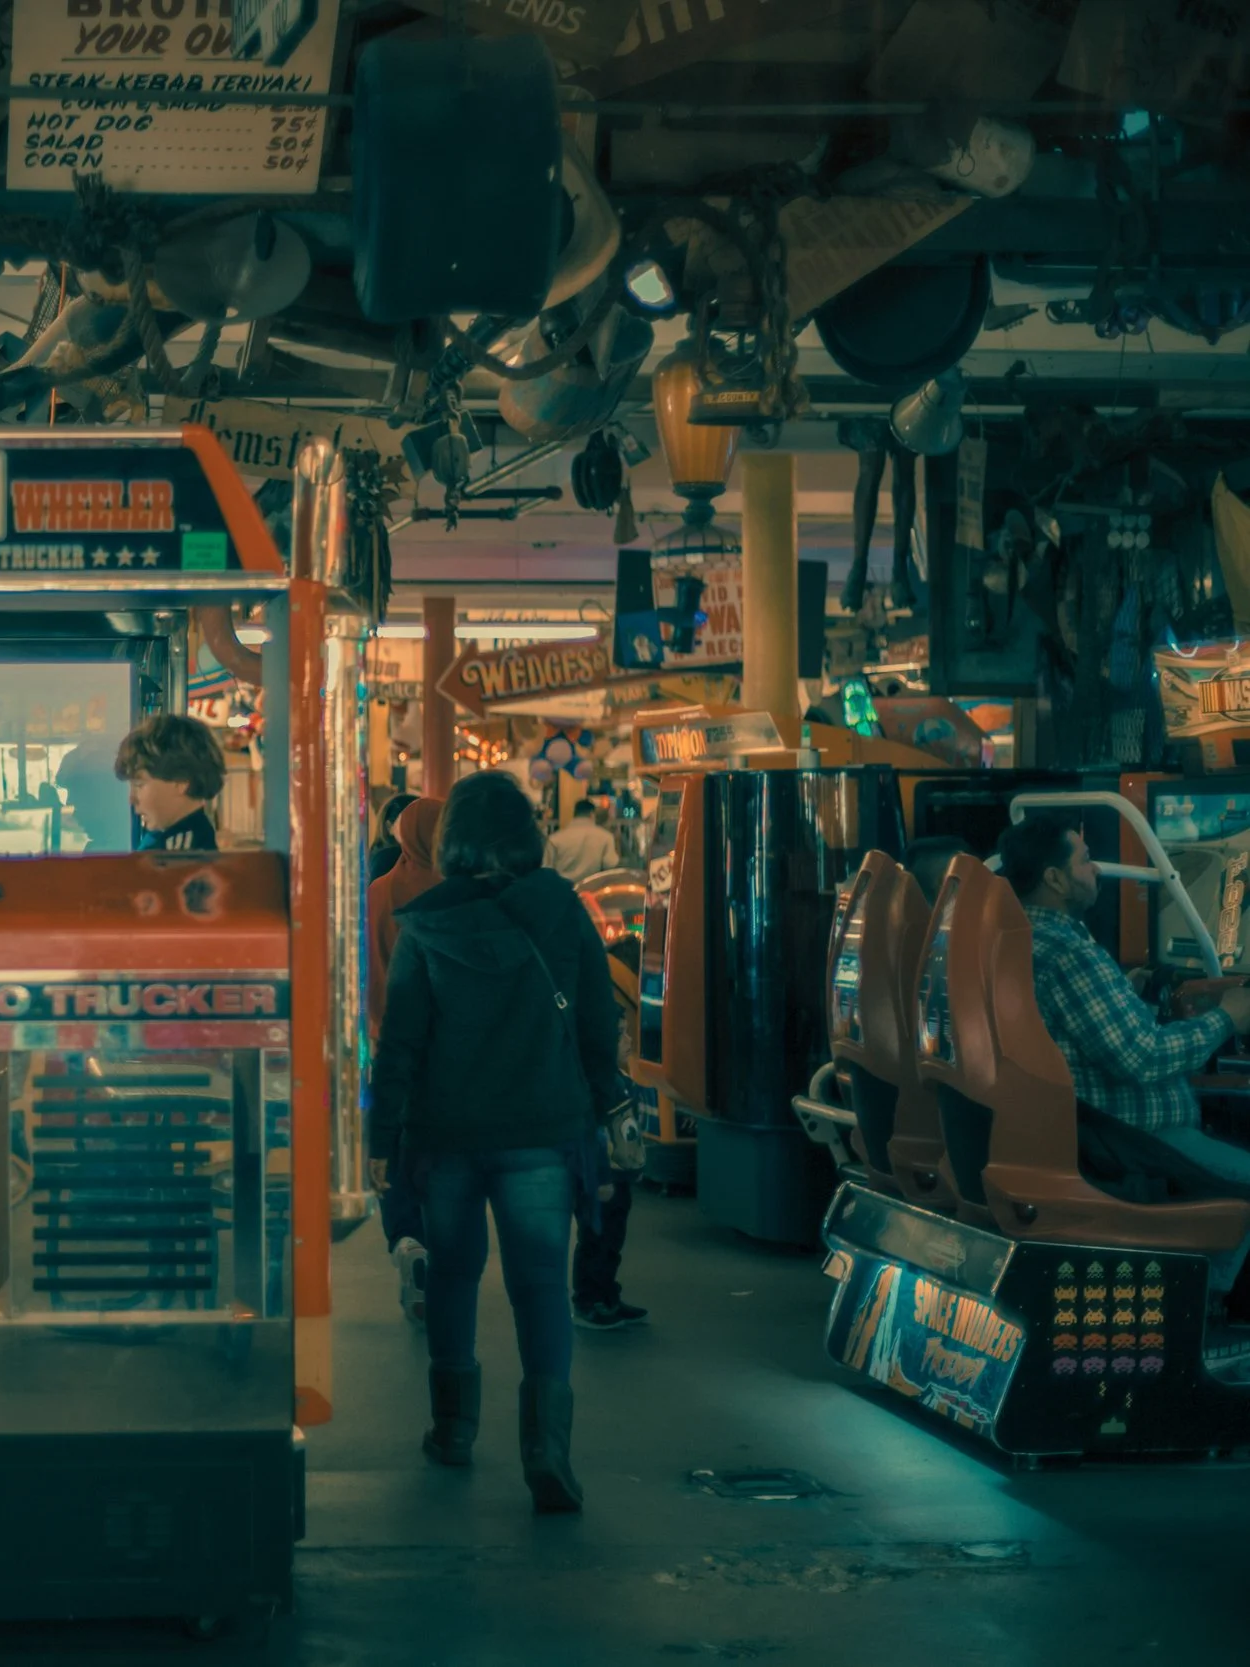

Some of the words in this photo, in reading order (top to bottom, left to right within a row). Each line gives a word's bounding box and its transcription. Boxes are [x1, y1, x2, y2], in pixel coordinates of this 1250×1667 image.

[74, 22, 171, 55] YOUR
[28, 73, 204, 93] STEAK-KEBAB
[211, 74, 313, 93] TERIYAKI
[26, 114, 81, 131] HOT
[94, 114, 154, 131] DOG
[270, 115, 318, 133] 75¢
[24, 133, 104, 150] SALAD
[265, 134, 316, 152] 50¢
[24, 152, 104, 168] CORN
[262, 154, 309, 173] 50¢
[12, 481, 175, 532] WHEELER
[460, 648, 595, 701] WEDGES
[43, 983, 278, 1016] TRUCKER
[913, 1278, 957, 1337] SPACE
[951, 1295, 1024, 1363] INVADERS
